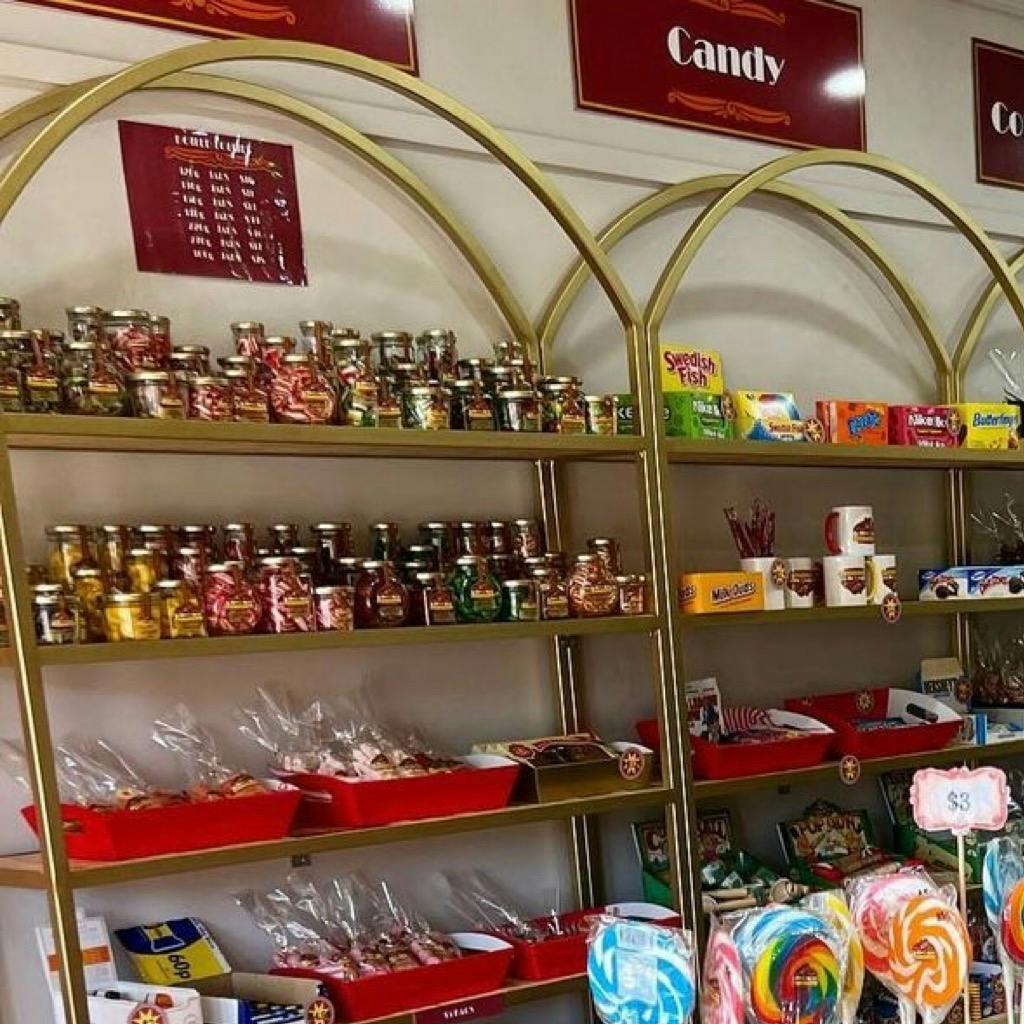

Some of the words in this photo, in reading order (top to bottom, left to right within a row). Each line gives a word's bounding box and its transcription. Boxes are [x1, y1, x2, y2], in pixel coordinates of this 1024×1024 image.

[667, 25, 785, 86] Candy
[663, 350, 715, 374] Swedish
[678, 367, 708, 388] Fish
[947, 790, 971, 812] $3
